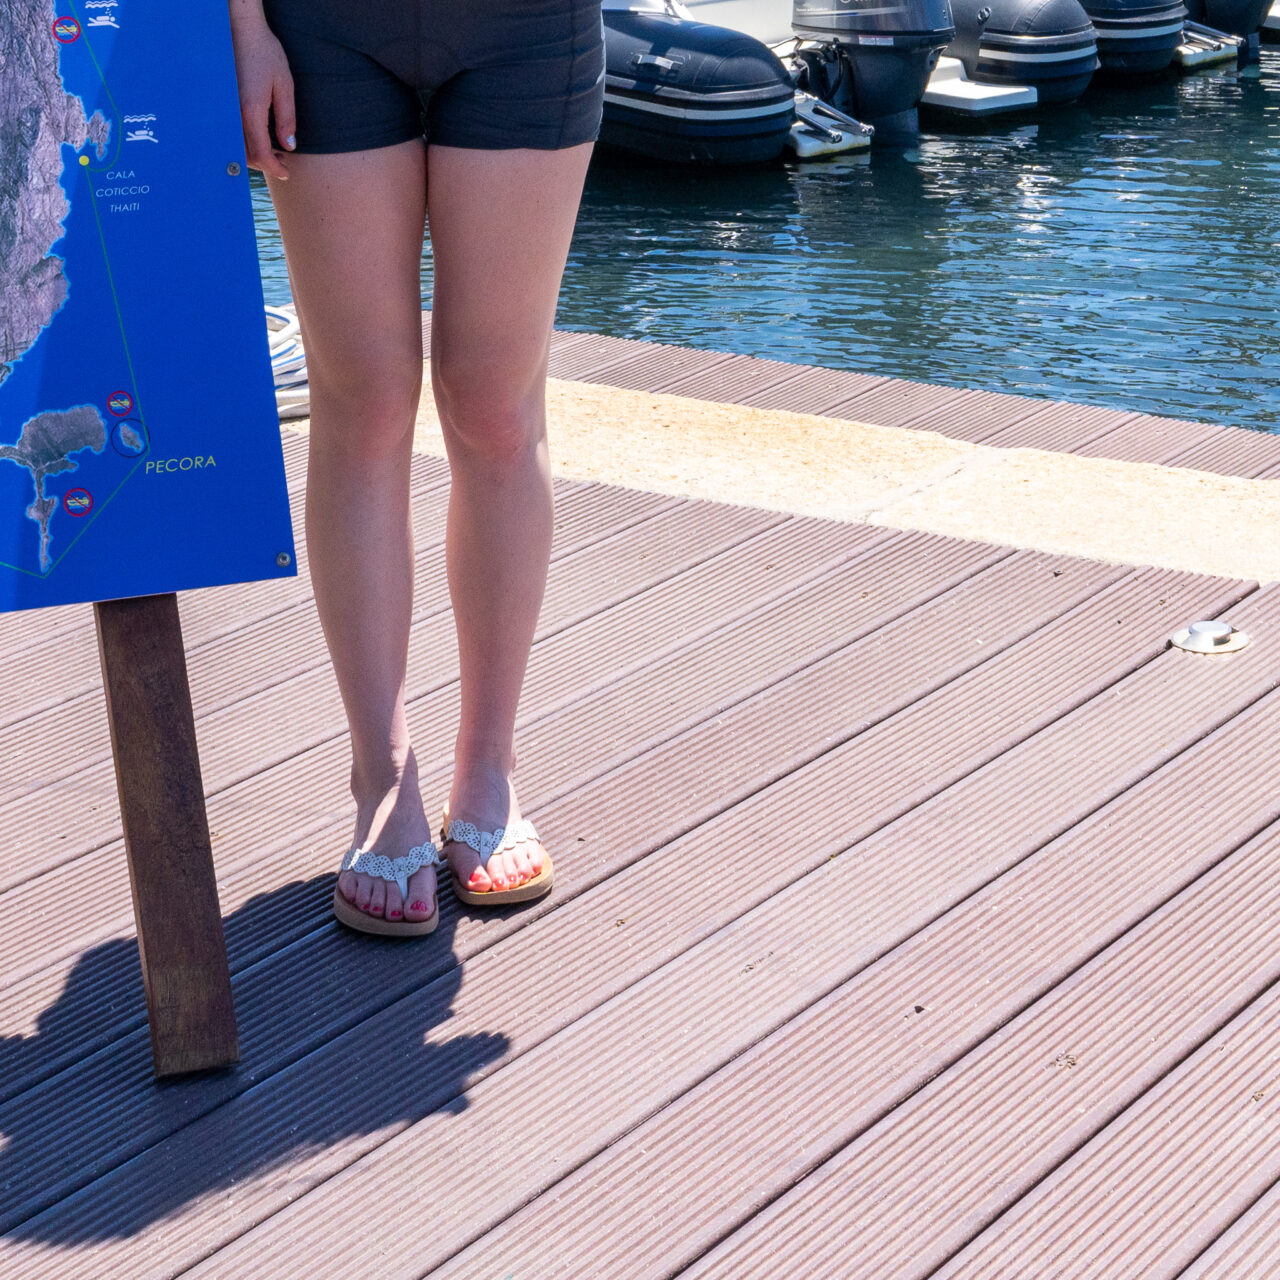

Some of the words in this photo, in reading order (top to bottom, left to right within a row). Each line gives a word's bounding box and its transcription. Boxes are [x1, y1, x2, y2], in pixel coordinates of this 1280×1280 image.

[105, 170, 136, 180] CALA
[95, 184, 151, 198] COTICCIO
[110, 202, 140, 213] THAITI
[145, 455, 217, 475] PECORA
